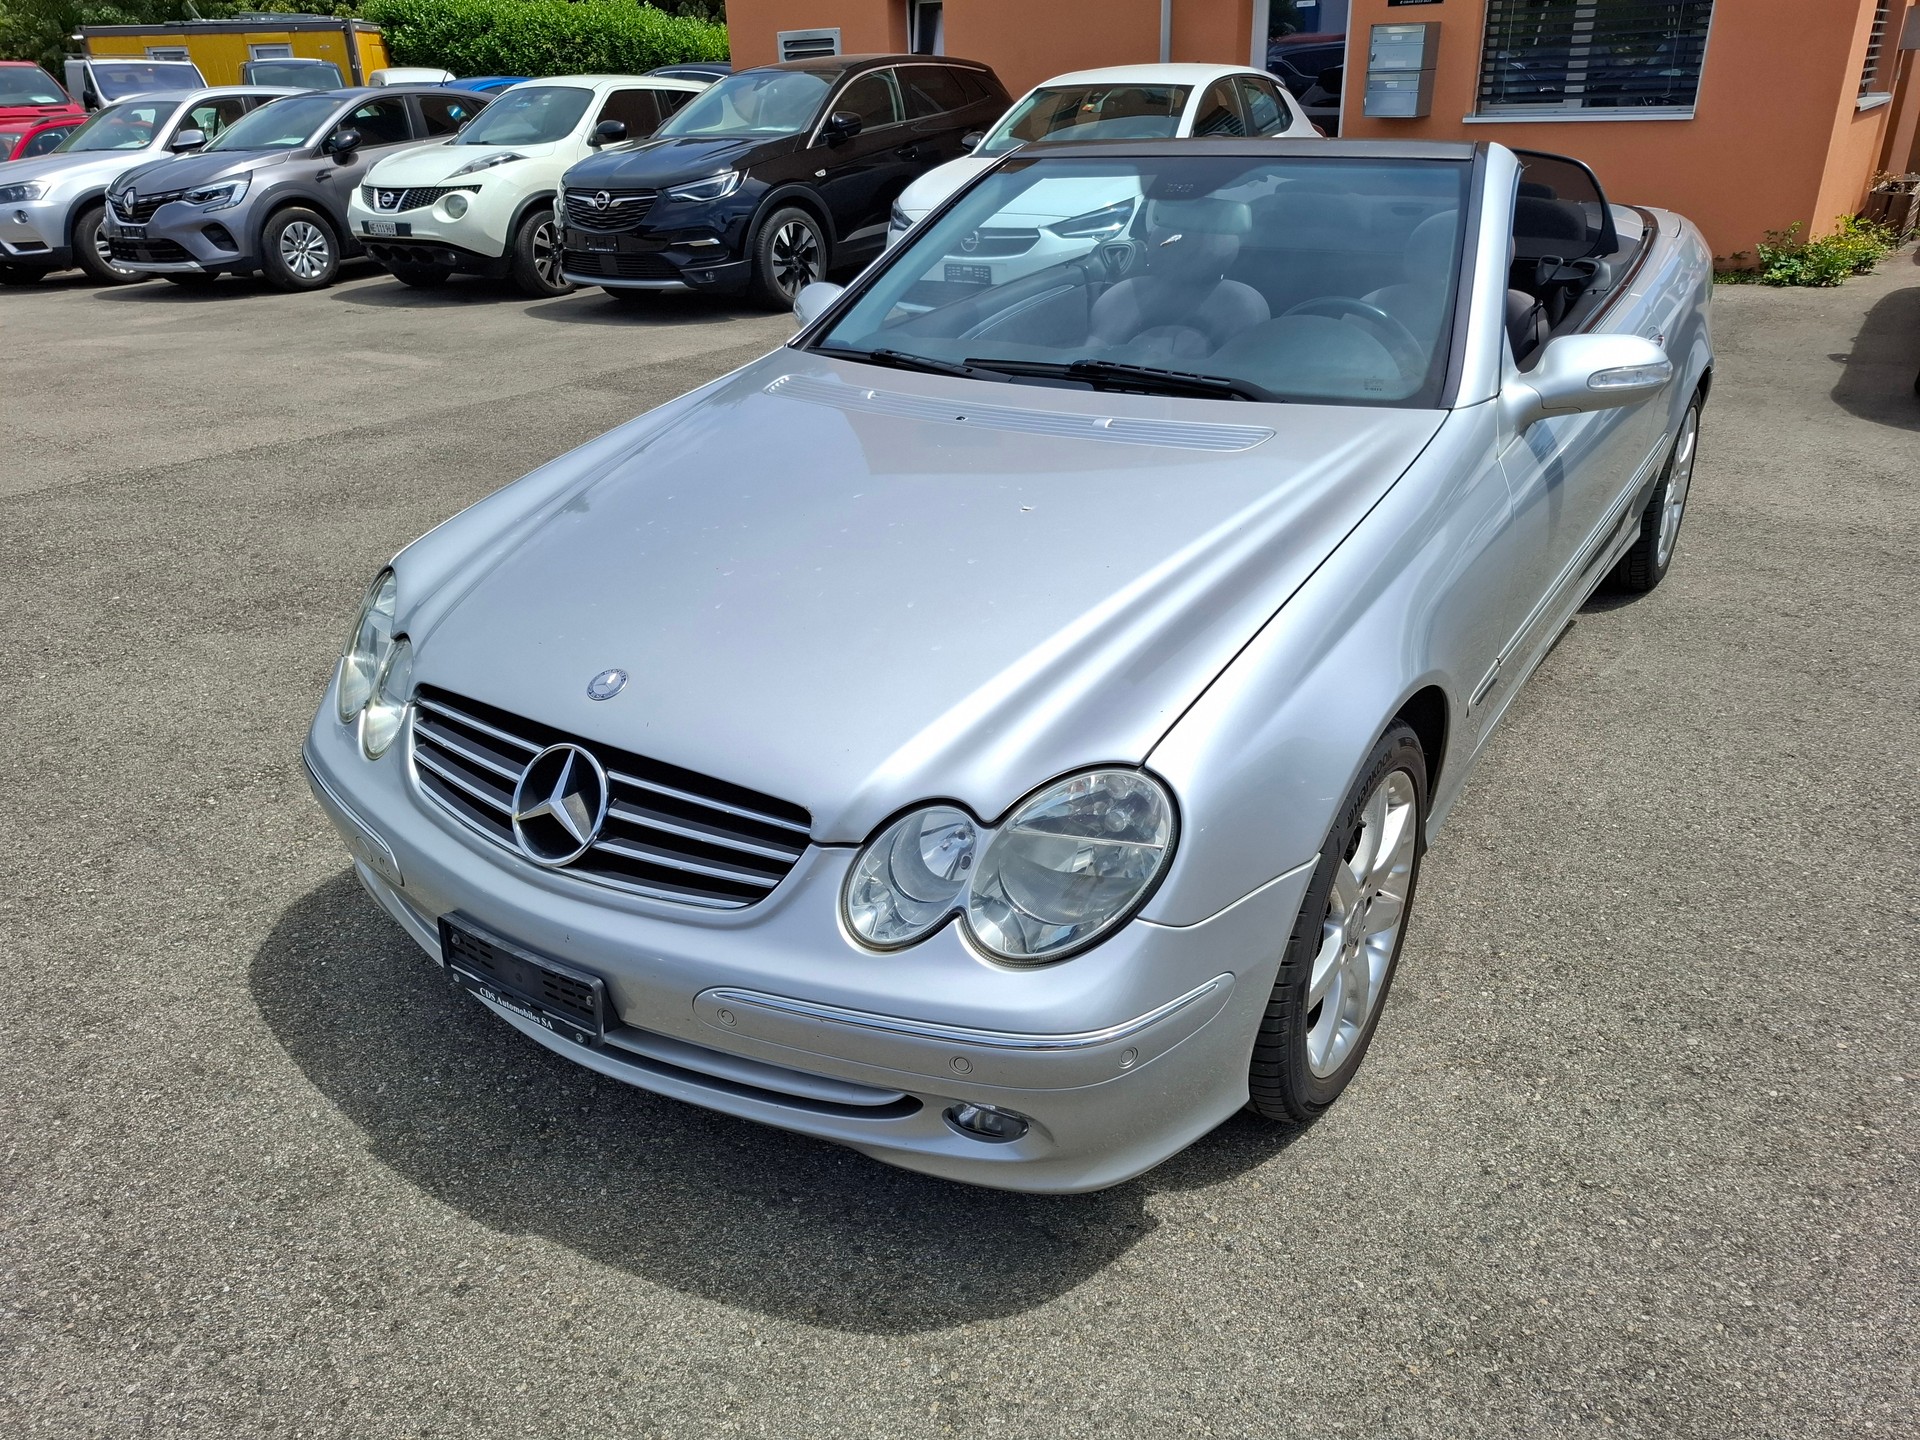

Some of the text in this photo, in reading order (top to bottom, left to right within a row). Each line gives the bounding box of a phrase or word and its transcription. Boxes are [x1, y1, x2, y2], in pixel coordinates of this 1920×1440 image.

[480, 987, 553, 1030] CDS Automobiles SA
